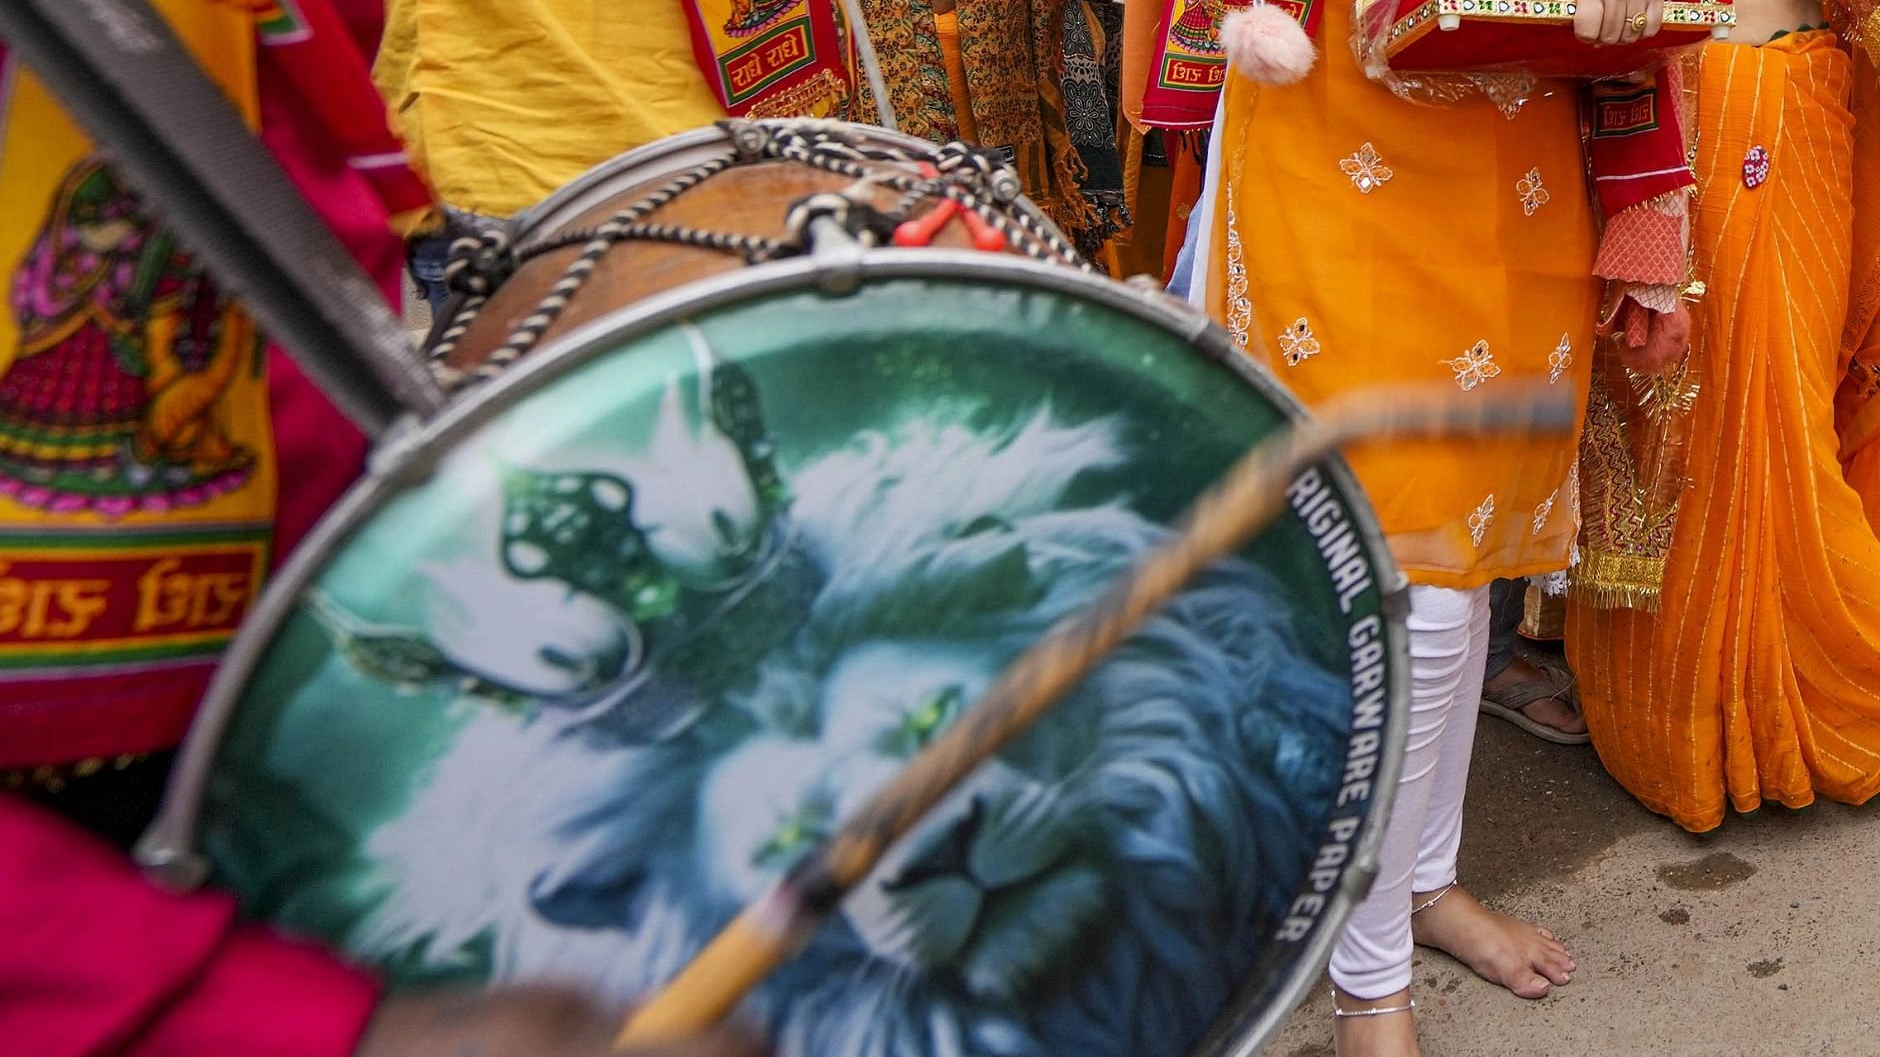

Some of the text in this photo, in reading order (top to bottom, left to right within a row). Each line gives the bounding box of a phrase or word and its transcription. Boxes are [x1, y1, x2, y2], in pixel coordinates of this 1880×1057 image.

[732, 34, 799, 87] राधे राधे
[1275, 468, 1387, 943] RIGINAL GARWARE PAPER
